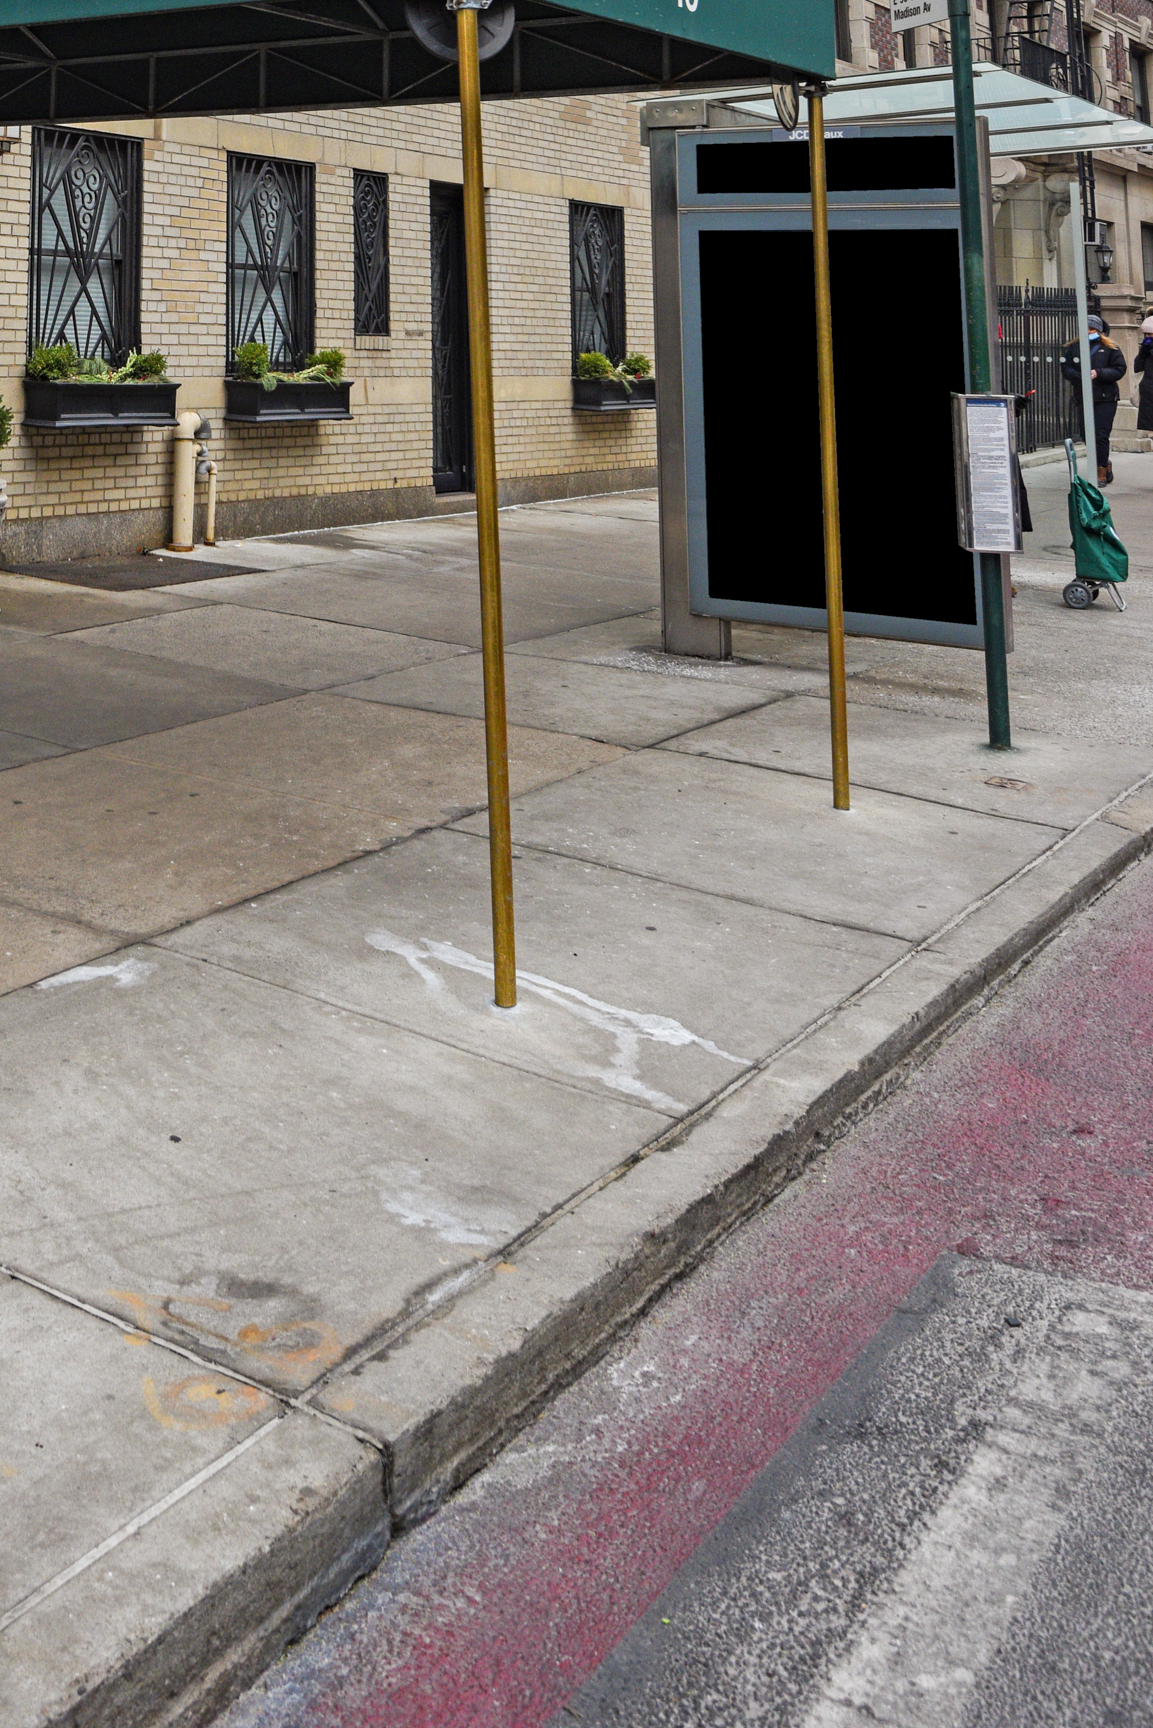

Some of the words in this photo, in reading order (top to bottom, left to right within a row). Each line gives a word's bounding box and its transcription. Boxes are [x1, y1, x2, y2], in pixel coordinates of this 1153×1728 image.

[894, 5, 921, 21] Madison
[922, 1, 932, 14] Av
[788, 130, 844, 140] JCDaux
